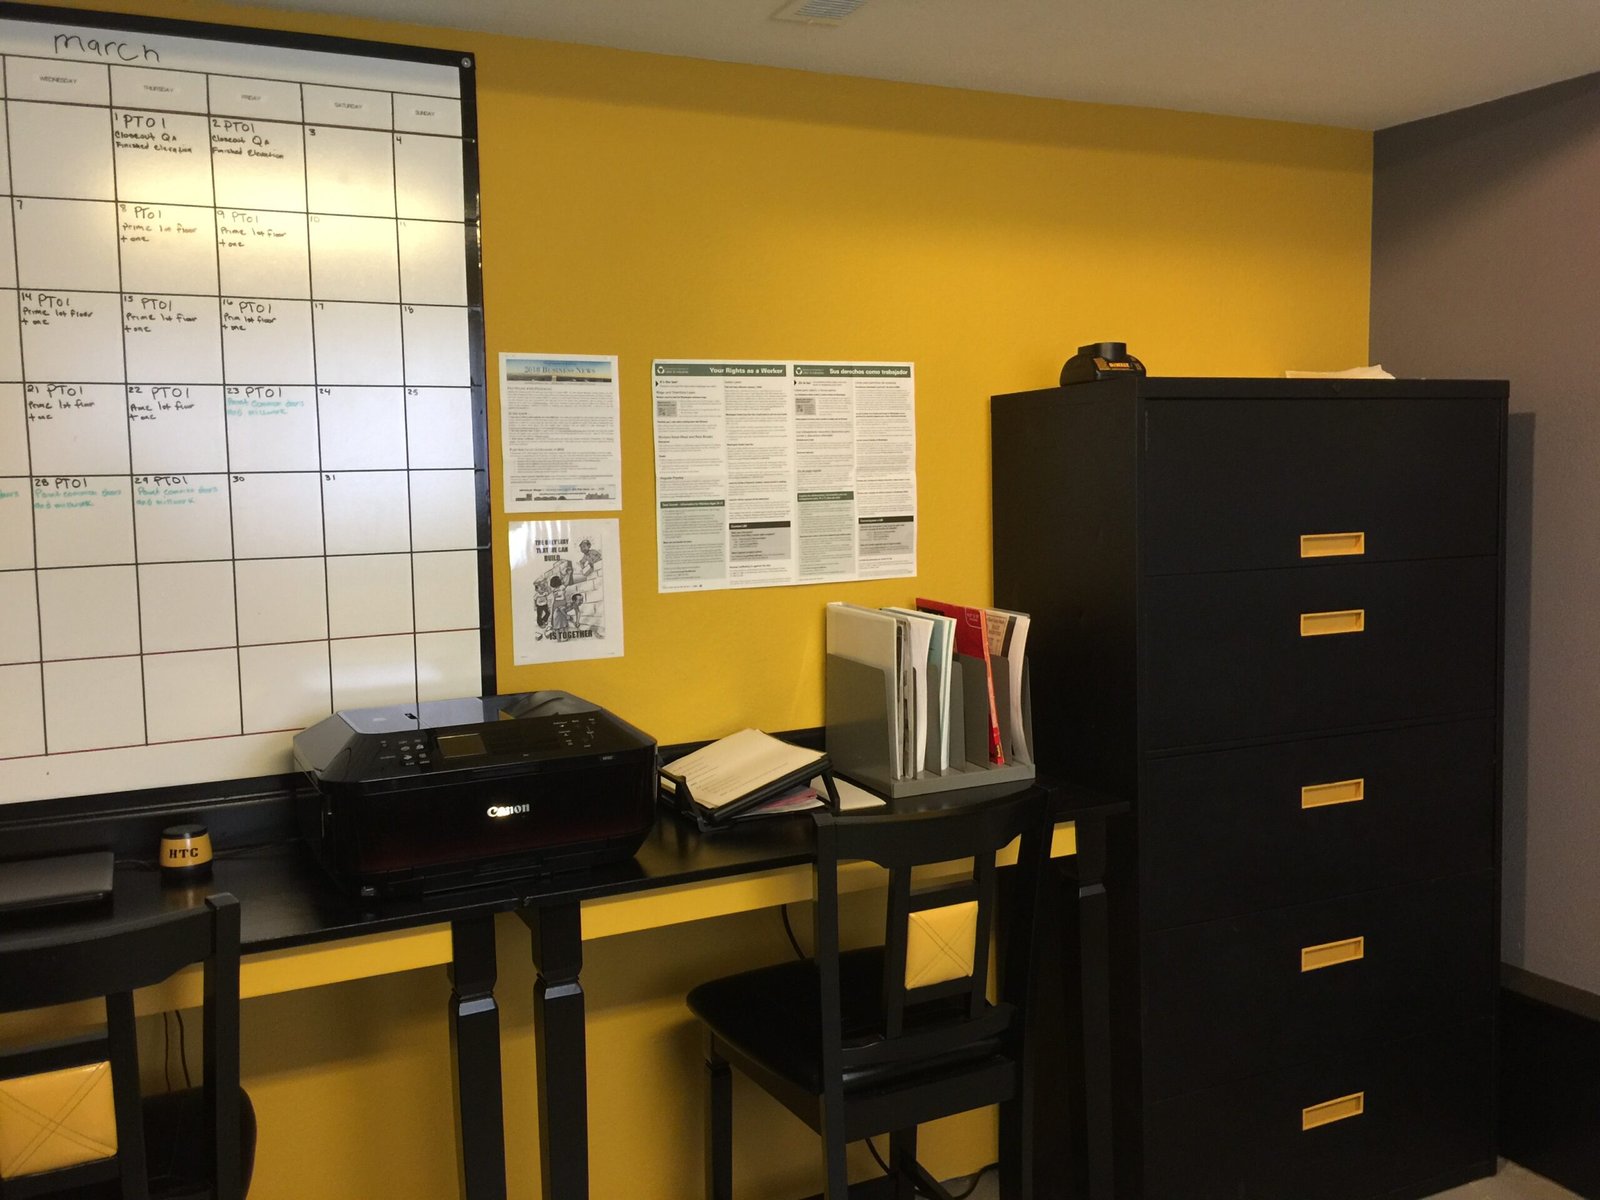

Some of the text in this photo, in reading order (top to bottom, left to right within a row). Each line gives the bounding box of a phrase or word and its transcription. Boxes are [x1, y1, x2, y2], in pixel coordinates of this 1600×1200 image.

[40, 75, 77, 84] WEDNESDAY
[143, 84, 175, 93] THURSDAY
[241, 94, 261, 102] FRIDAY
[334, 102, 362, 110] SATURDAY
[212, 119, 221, 128] 2
[308, 128, 316, 136] 3
[396, 136, 402, 145] 4
[17, 200, 22, 210] 7
[120, 204, 127, 212] 8
[216, 210, 225, 219] 9
[122, 222, 152, 232] Prime
[220, 226, 246, 236] Prime
[21, 292, 32, 301] 14
[223, 298, 234, 306] 16
[22, 307, 50, 316] Prime
[404, 306, 414, 314] 18
[126, 312, 156, 322] Prime
[726, 367, 745, 376] Rights
[27, 385, 39, 394] 21
[129, 386, 143, 394] 22
[227, 387, 240, 395] 23
[319, 388, 330, 396] 24
[407, 388, 418, 396] 25
[232, 475, 245, 483] 30
[325, 474, 336, 482] 31
[35, 479, 49, 488] 28
[550, 629, 593, 640] IS TOGETHER
[486, 803, 530, 818] Canon
